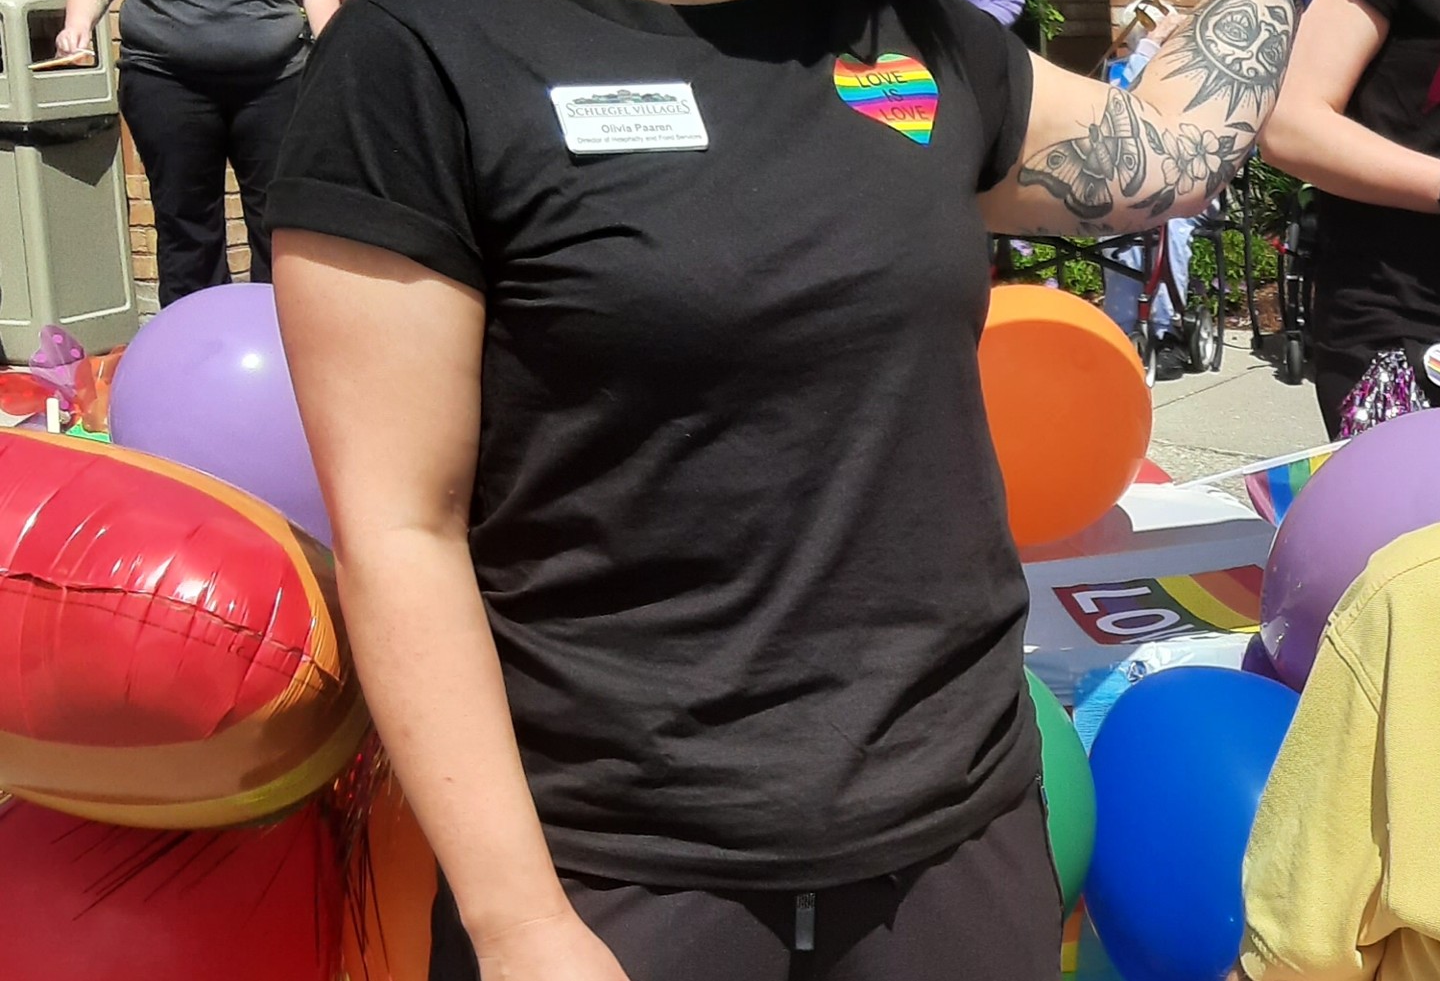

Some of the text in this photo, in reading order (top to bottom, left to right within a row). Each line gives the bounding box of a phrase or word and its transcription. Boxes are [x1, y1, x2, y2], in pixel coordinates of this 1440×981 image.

[855, 71, 908, 88] LOVE
[882, 89, 904, 102] IS
[565, 99, 691, 118] SCHLEGEL VILLAGES
[879, 105, 930, 121] LOVE
[601, 124, 632, 133] Olivia
